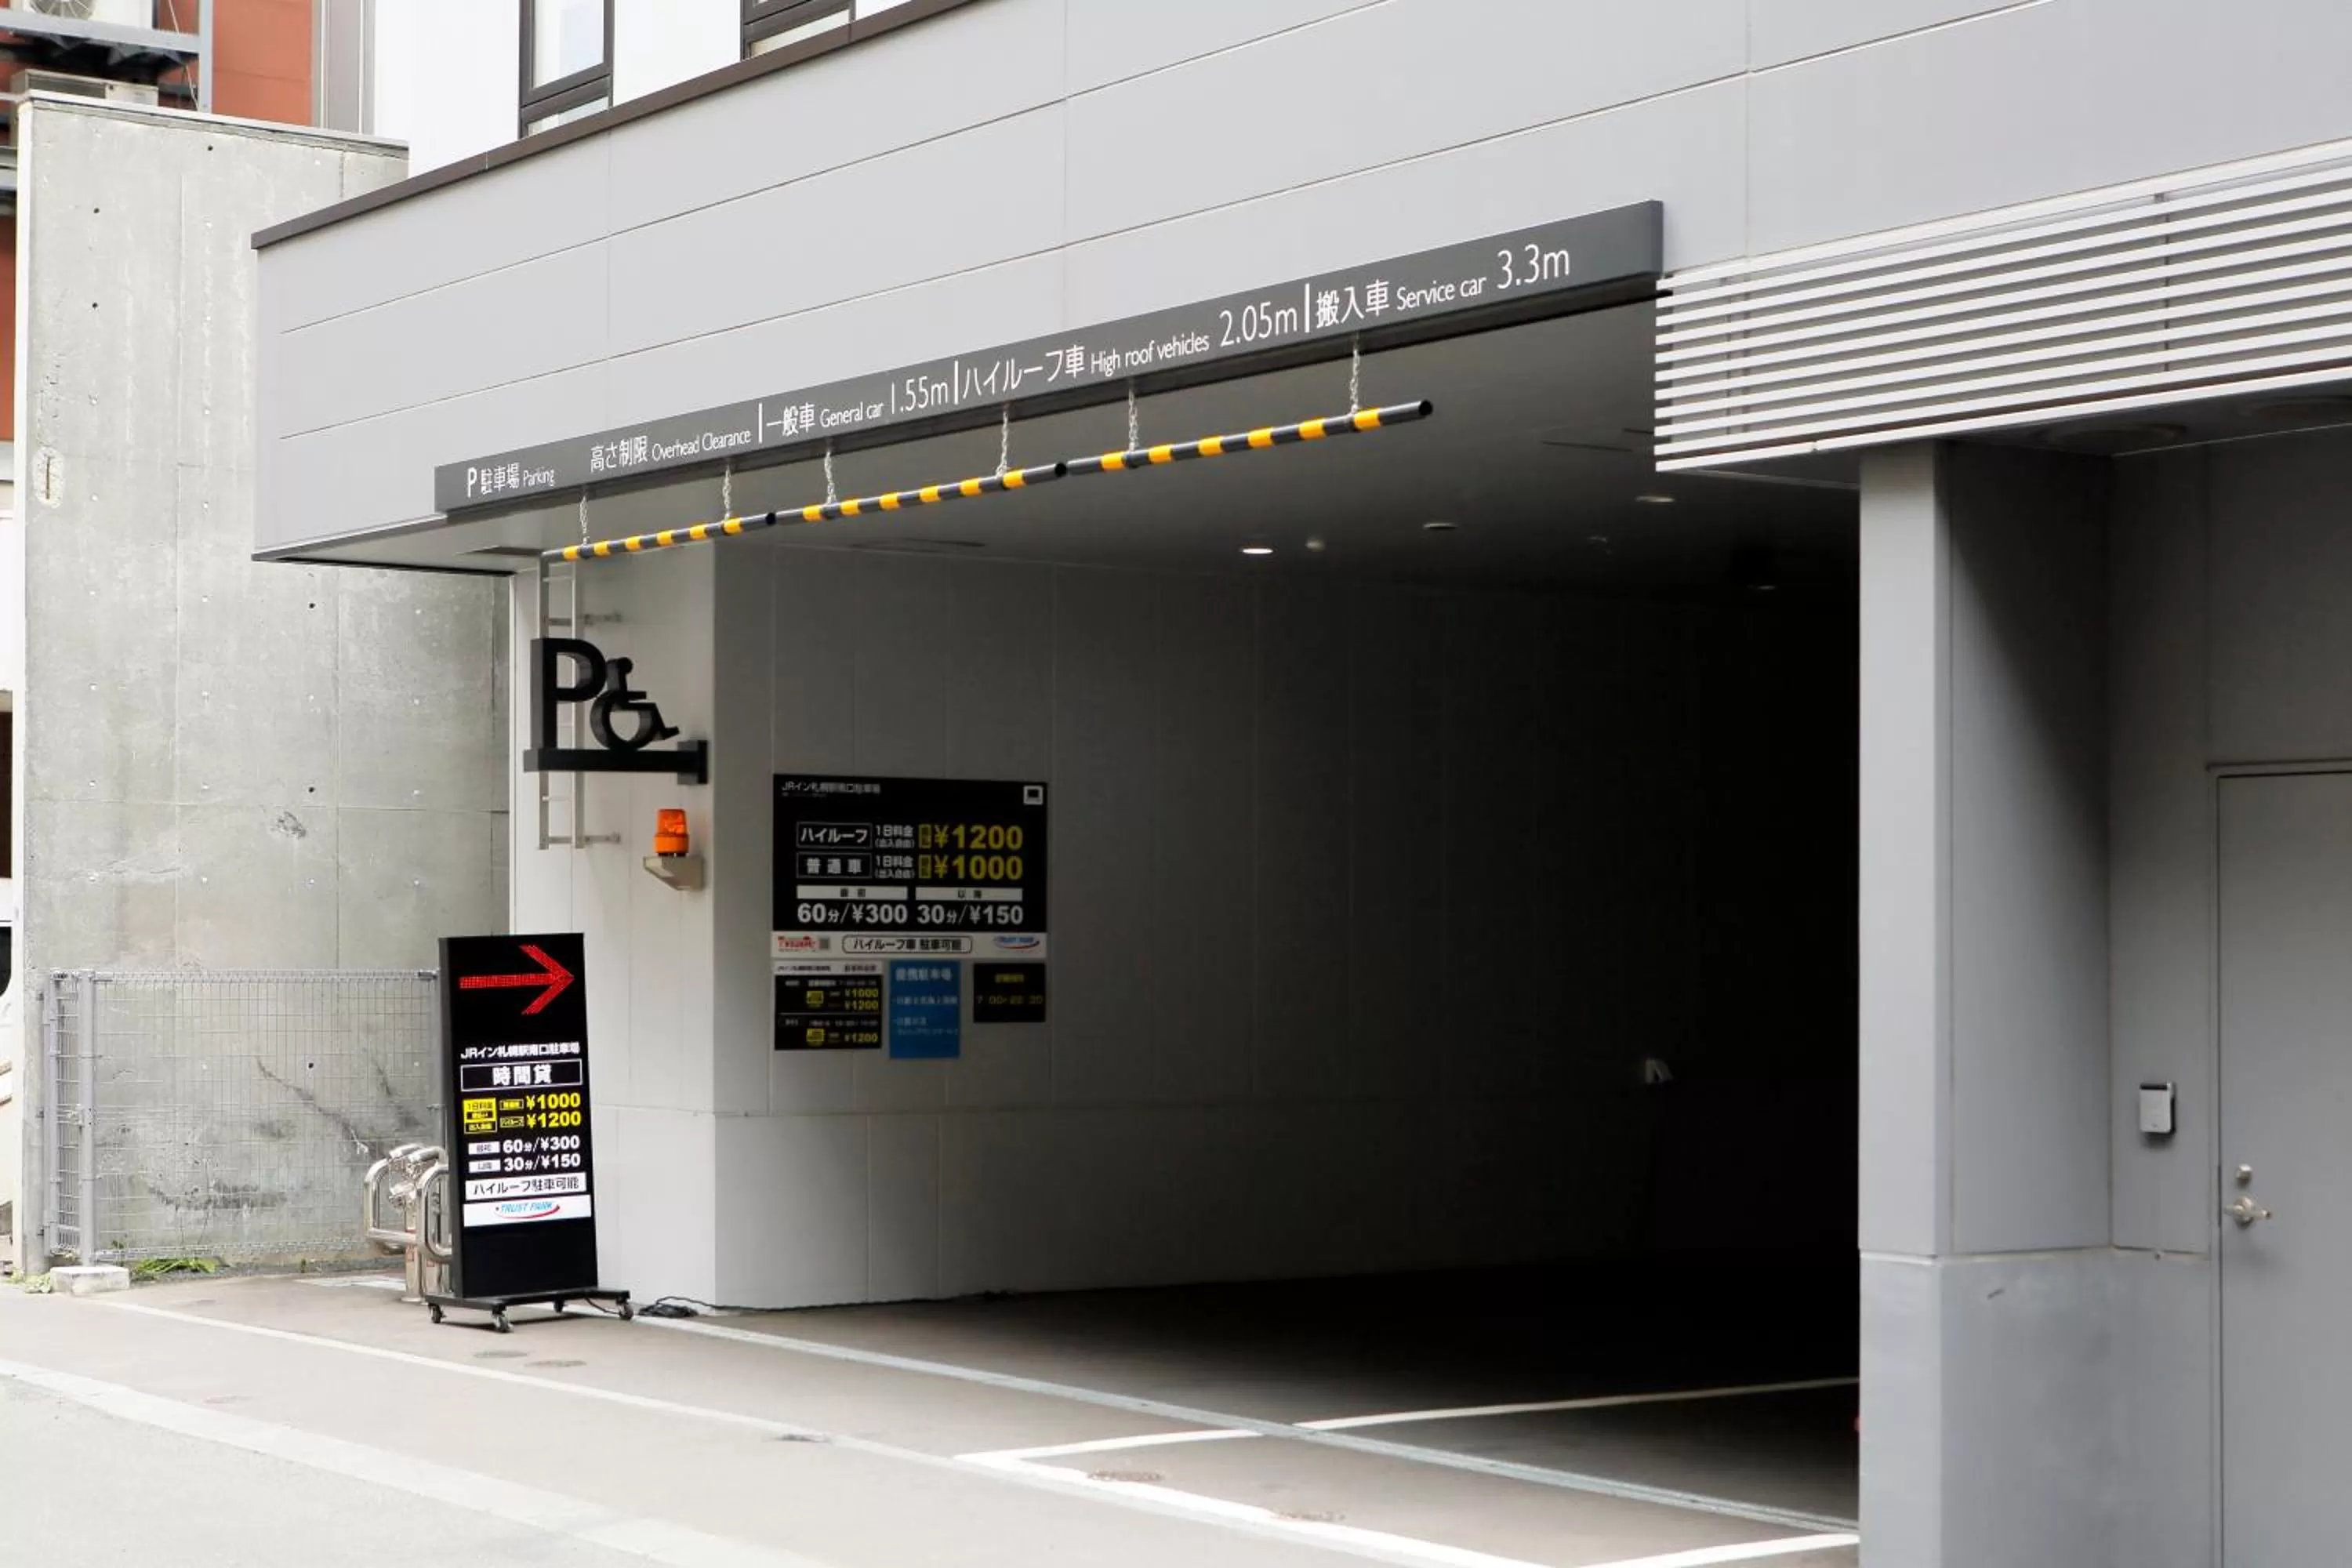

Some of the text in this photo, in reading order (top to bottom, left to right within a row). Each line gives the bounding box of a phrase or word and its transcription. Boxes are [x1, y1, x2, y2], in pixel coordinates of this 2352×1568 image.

[523, 468, 554, 487] Parking
[590, 435, 648, 473] 高さ制限
[652, 436, 700, 461] Overhead
[702, 430, 751, 451] Clearance
[766, 402, 816, 437] 一般車
[819, 401, 863, 428] General
[866, 402, 884, 419] car
[891, 376, 949, 415] 1.55m
[963, 344, 1085, 399] ハイルーフ車
[1091, 348, 1120, 378] High
[1125, 339, 1155, 368] roof
[1156, 332, 1210, 360] vehicles
[1219, 301, 1298, 347] 2.05m
[1316, 279, 1390, 329] 搬入車
[1396, 280, 1455, 310] Service
[1460, 277, 1487, 297] car
[1497, 243, 1570, 290] 3.3m
[531, 638, 606, 750] P
[934, 824, 1023, 850] ¥1200
[934, 854, 1023, 880] ¥1000
[525, 1093, 581, 1110] ¥1000
[527, 1111, 582, 1128] ¥1200
